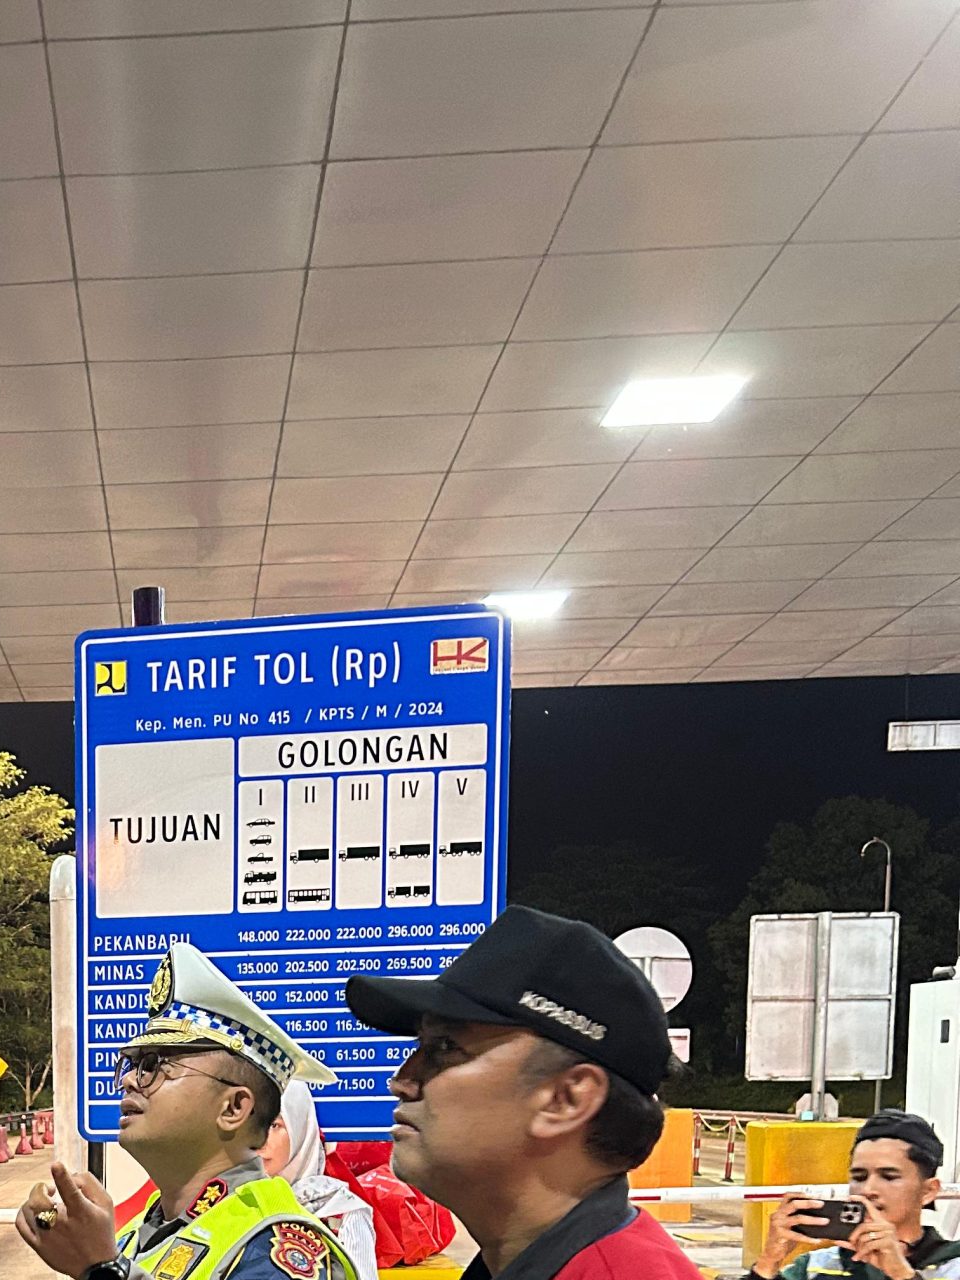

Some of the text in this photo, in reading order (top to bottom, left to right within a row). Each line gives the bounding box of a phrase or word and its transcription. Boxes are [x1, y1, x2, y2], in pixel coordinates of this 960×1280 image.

[147, 641, 401, 692] TARIF TOL (Rp)
[136, 702, 443, 733] Kep. Men. PU No 415 / KPTS / M / 2024
[278, 732, 448, 769] GOLONGAN
[258, 777, 468, 806] I II III IV V
[109, 813, 221, 844] TUJUAN
[238, 930, 280, 943] 148.000
[285, 928, 332, 942] 222.000
[336, 926, 383, 940] 222.000
[387, 924, 434, 938] 296.000
[439, 922, 486, 936] 296.000
[94, 964, 144, 981] MINAS
[237, 962, 279, 975] 135.000
[285, 960, 330, 974] 202.500
[336, 957, 382, 972] 202.500
[386, 956, 433, 970] 269.500
[285, 990, 329, 1003] 152.000
[285, 1020, 328, 1032] 116.500
[336, 1048, 376, 1061] 61.500
[337, 1079, 375, 1092] 71.500
